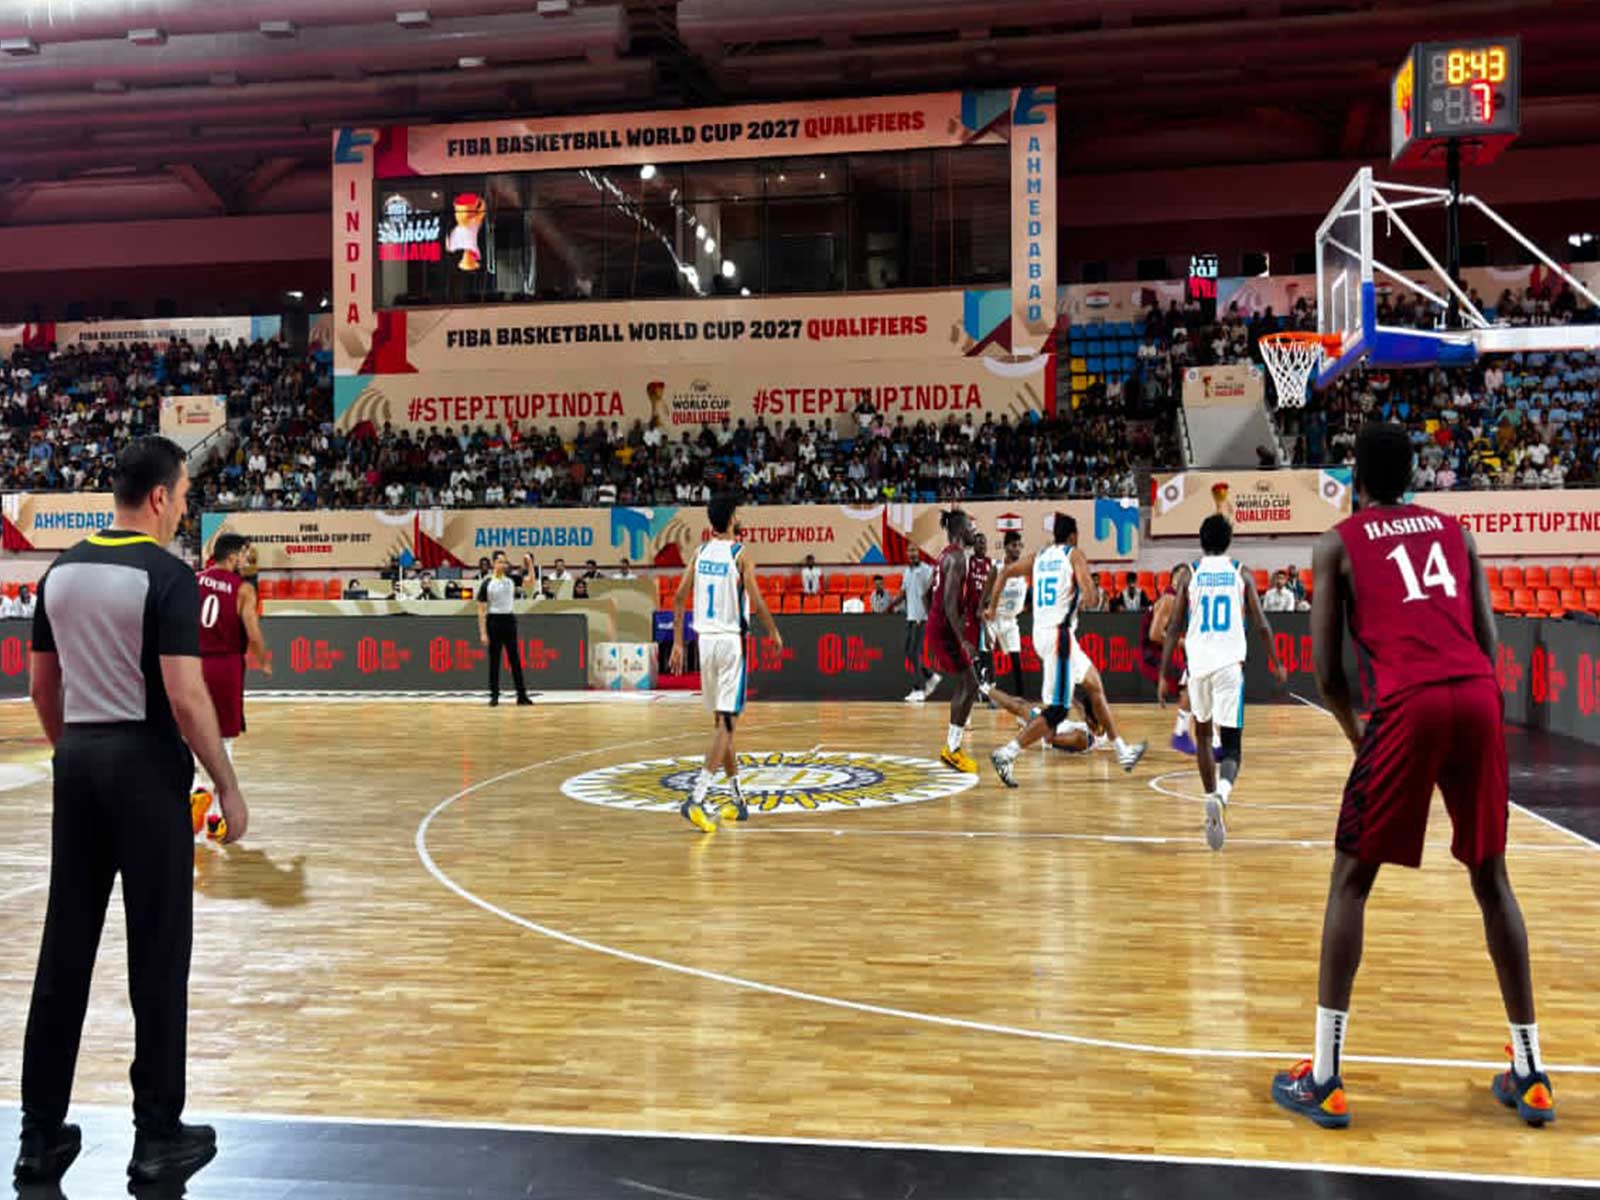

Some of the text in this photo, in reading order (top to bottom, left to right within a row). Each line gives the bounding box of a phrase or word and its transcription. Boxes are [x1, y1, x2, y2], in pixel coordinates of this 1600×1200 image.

[1447, 46, 1506, 84] 8:43
[1471, 82, 1491, 121] 7
[447, 111, 925, 157] FIBA BASKETBALL WORLD CUP 2027 QUALIFIERS
[1027, 136, 1042, 322] AHMEDABAD
[345, 181, 360, 324] INDIA
[447, 315, 928, 348] FIBA BASKETBALL WORLD CUP 2027 QUALIFIERS
[407, 390, 624, 422] #STEPITUPINDIA
[34, 511, 115, 529] AHMEDABA
[1236, 499, 1290, 508] WORLD CUP
[1236, 509, 1291, 523] QUALIFIERS
[475, 527, 594, 547] AHMEDABAD
[1364, 515, 1444, 540] HASHIM
[1386, 541, 1457, 603] 14
[706, 584, 715, 618] 1
[1037, 577, 1059, 608] 15
[201, 594, 220, 628] 0
[1201, 595, 1231, 632] 10
